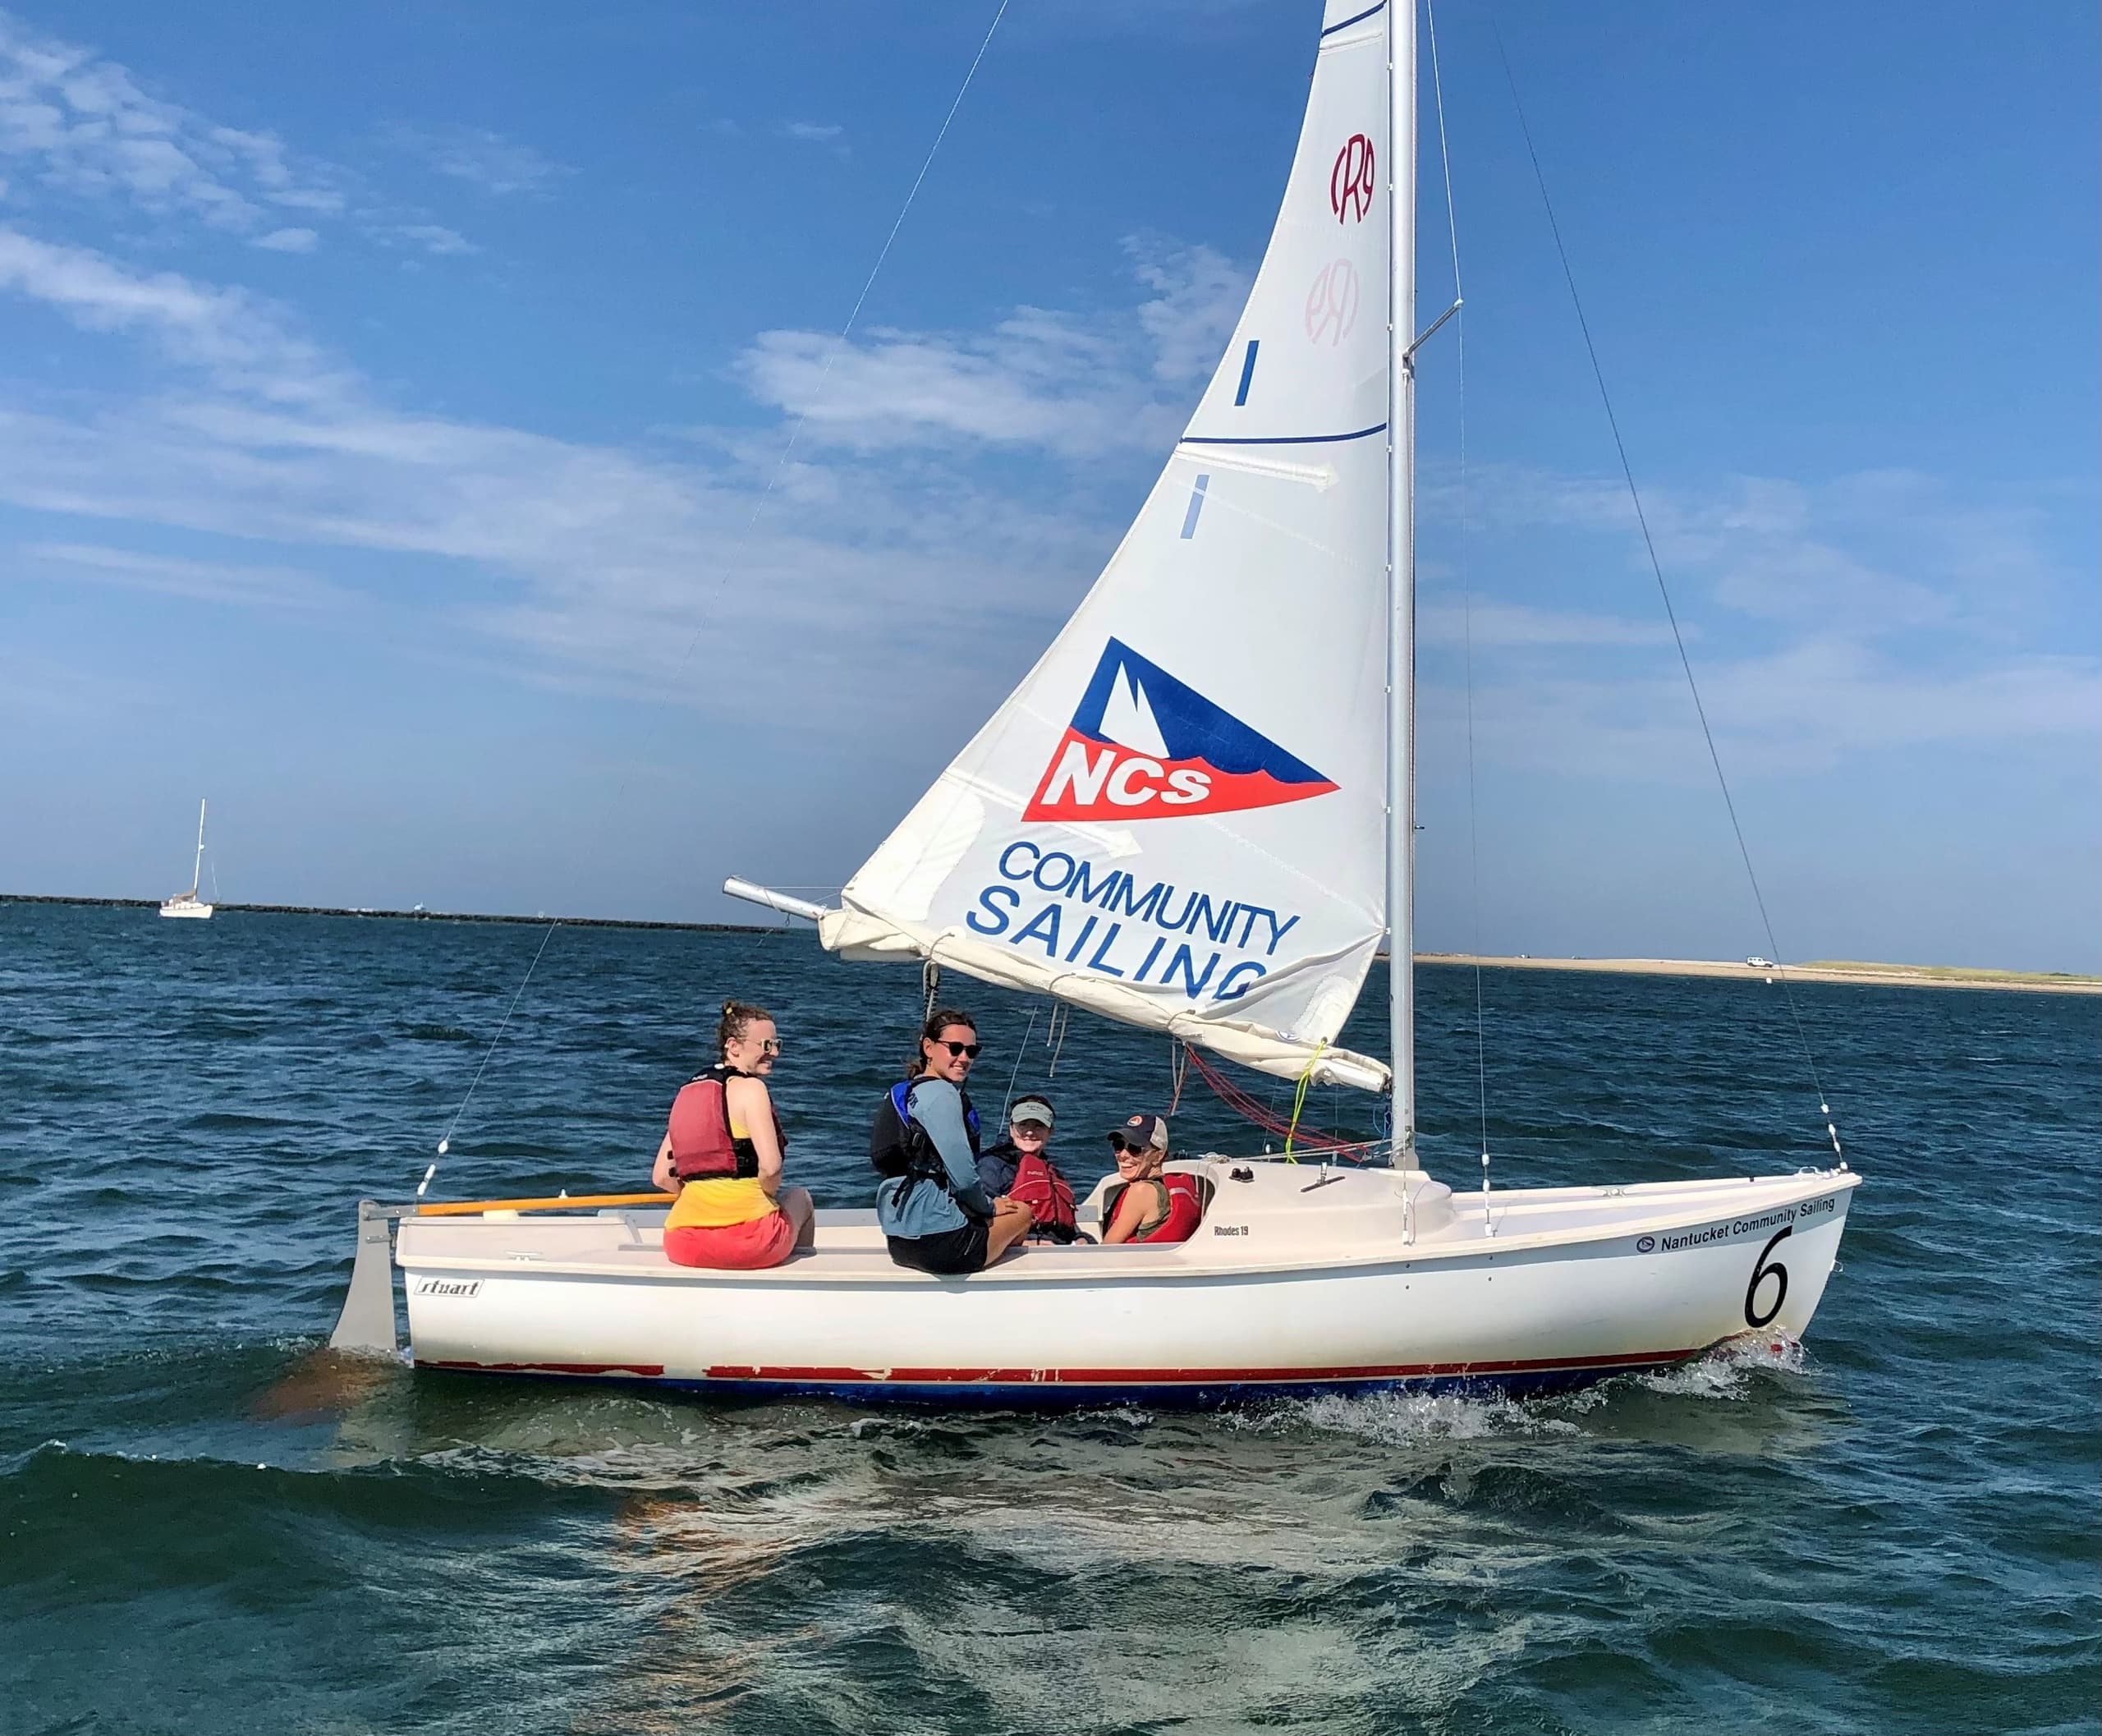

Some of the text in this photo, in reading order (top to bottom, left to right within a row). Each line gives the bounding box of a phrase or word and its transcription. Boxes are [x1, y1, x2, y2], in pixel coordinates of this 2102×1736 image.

[1040, 740, 1212, 806] NCS
[998, 841, 1301, 956] COMMUNITY
[966, 885, 1267, 1001] SAILING
[1214, 1226, 1249, 1236] Rhodes 19
[1661, 1197, 1835, 1251] Nantucket Community Sailing
[1744, 1224, 1793, 1329] 6
